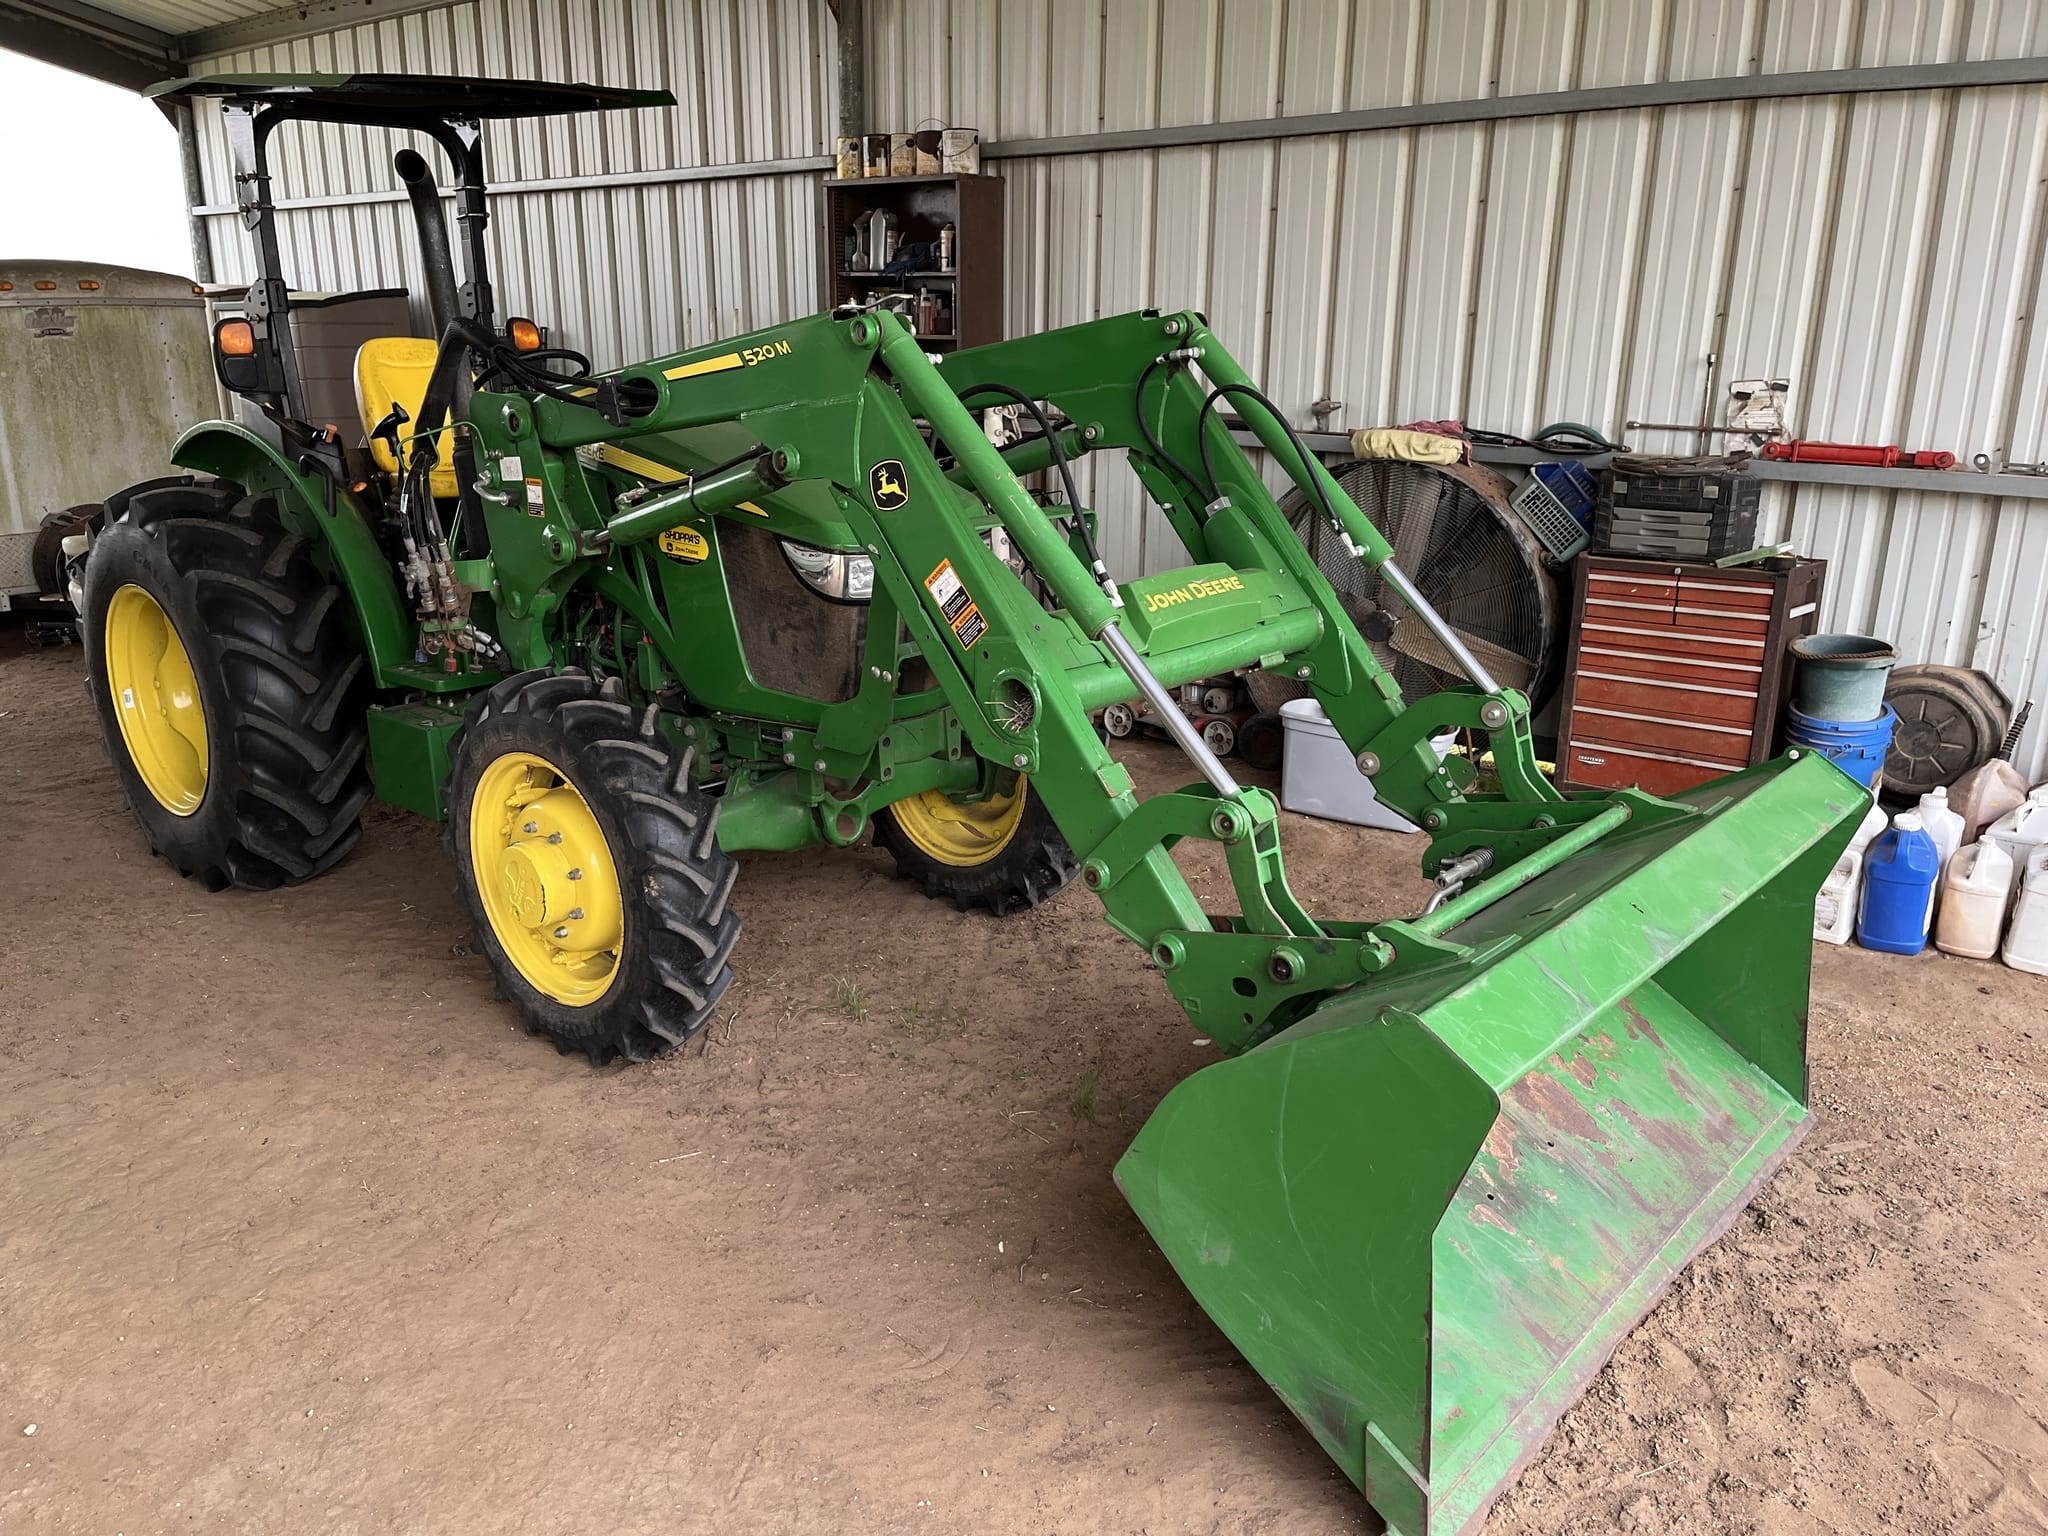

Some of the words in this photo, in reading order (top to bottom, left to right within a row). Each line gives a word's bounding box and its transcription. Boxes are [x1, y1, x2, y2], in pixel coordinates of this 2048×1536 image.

[742, 344, 776, 367] 520
[774, 339, 792, 356] M
[664, 530, 701, 545] SHOPPA'S
[1145, 588, 1194, 613] JOHN
[1187, 576, 1245, 599] DEERE
